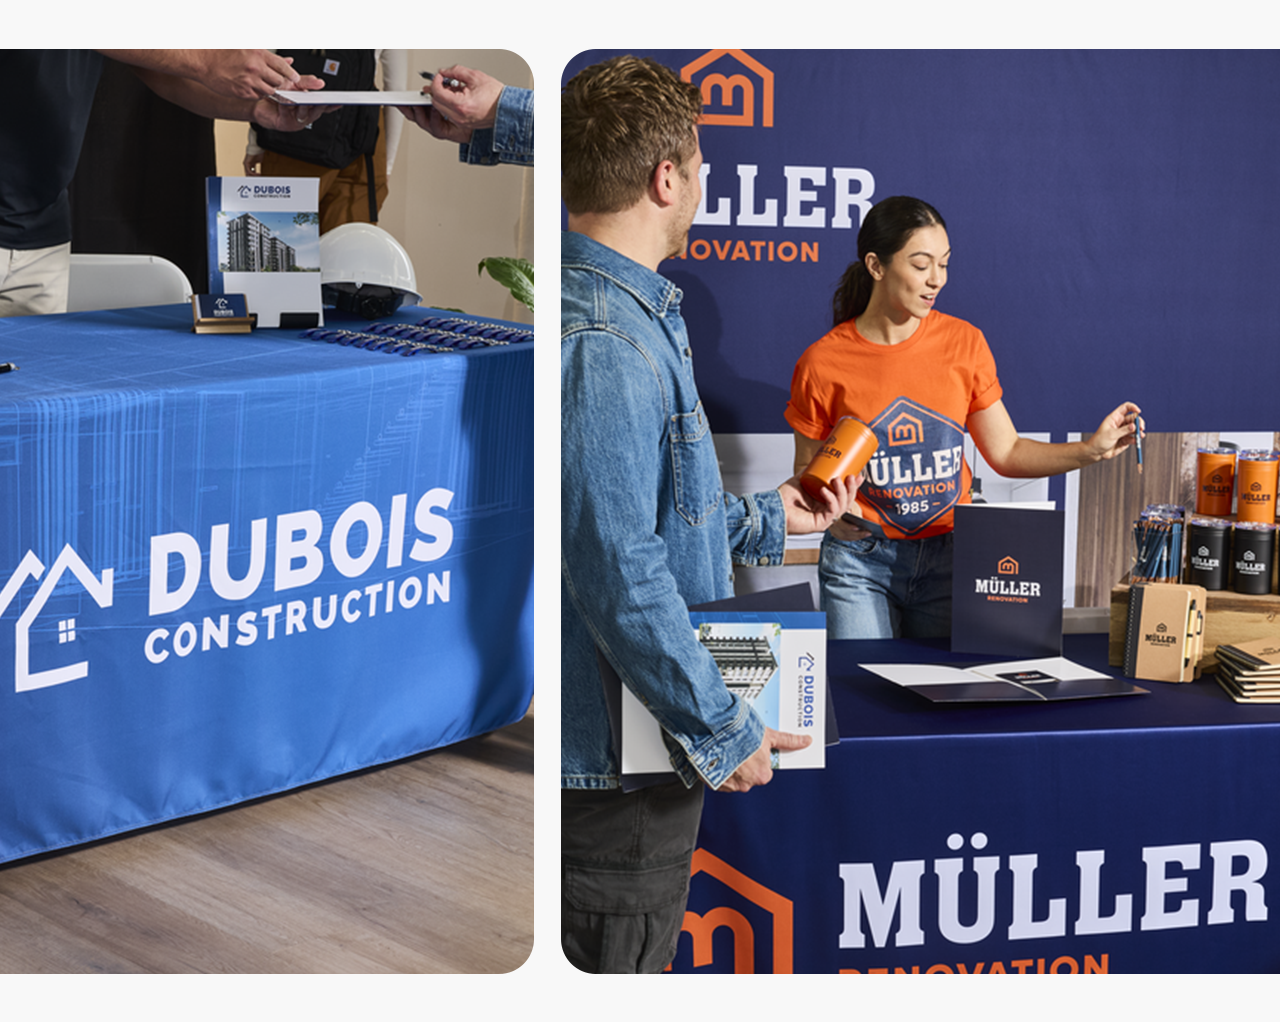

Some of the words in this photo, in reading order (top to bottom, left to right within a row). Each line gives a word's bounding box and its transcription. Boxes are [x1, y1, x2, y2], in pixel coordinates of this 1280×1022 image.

[254, 185, 291, 194] DUBOIS
[868, 479, 955, 499] RENOVATION
[148, 487, 455, 616] DUBOIS
[975, 576, 1041, 597] MÜLLER
[144, 570, 451, 664] CONSTRUCTION
[803, 675, 814, 727] DUBOIS
[838, 832, 1269, 949] MÜLLER
